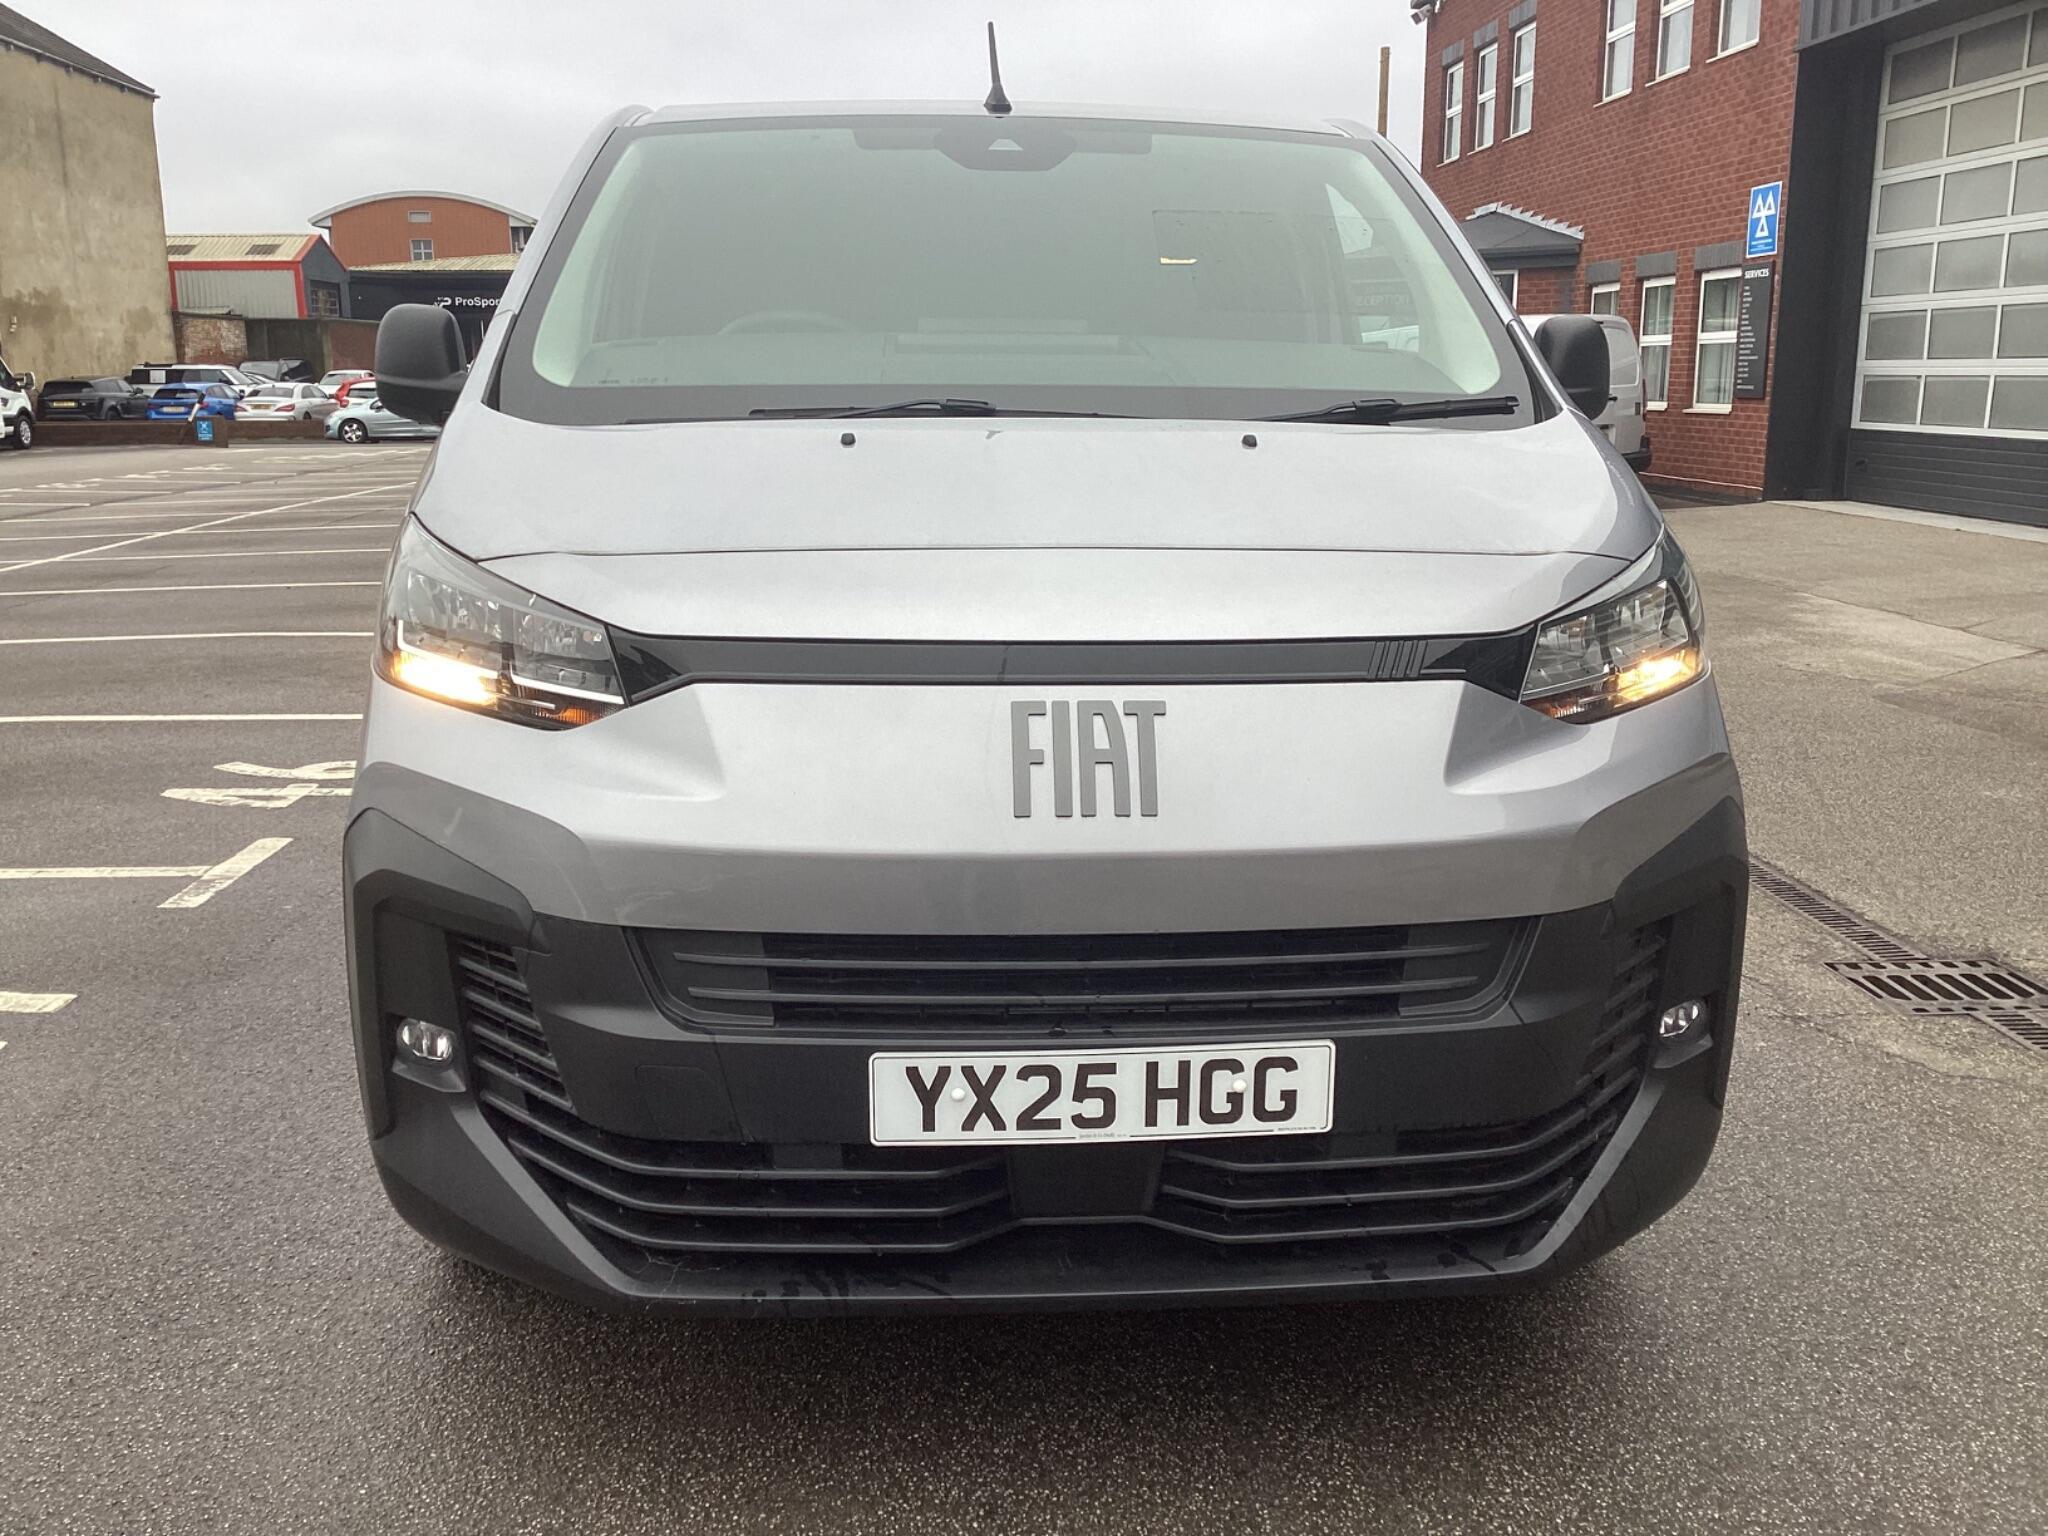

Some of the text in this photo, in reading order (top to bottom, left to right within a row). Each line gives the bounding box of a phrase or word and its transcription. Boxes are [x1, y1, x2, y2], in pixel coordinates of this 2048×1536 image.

[1744, 268, 1769, 279] SERVICES
[1011, 700, 1166, 818] FIAT
[905, 1056, 1299, 1132] YX25 HGG
